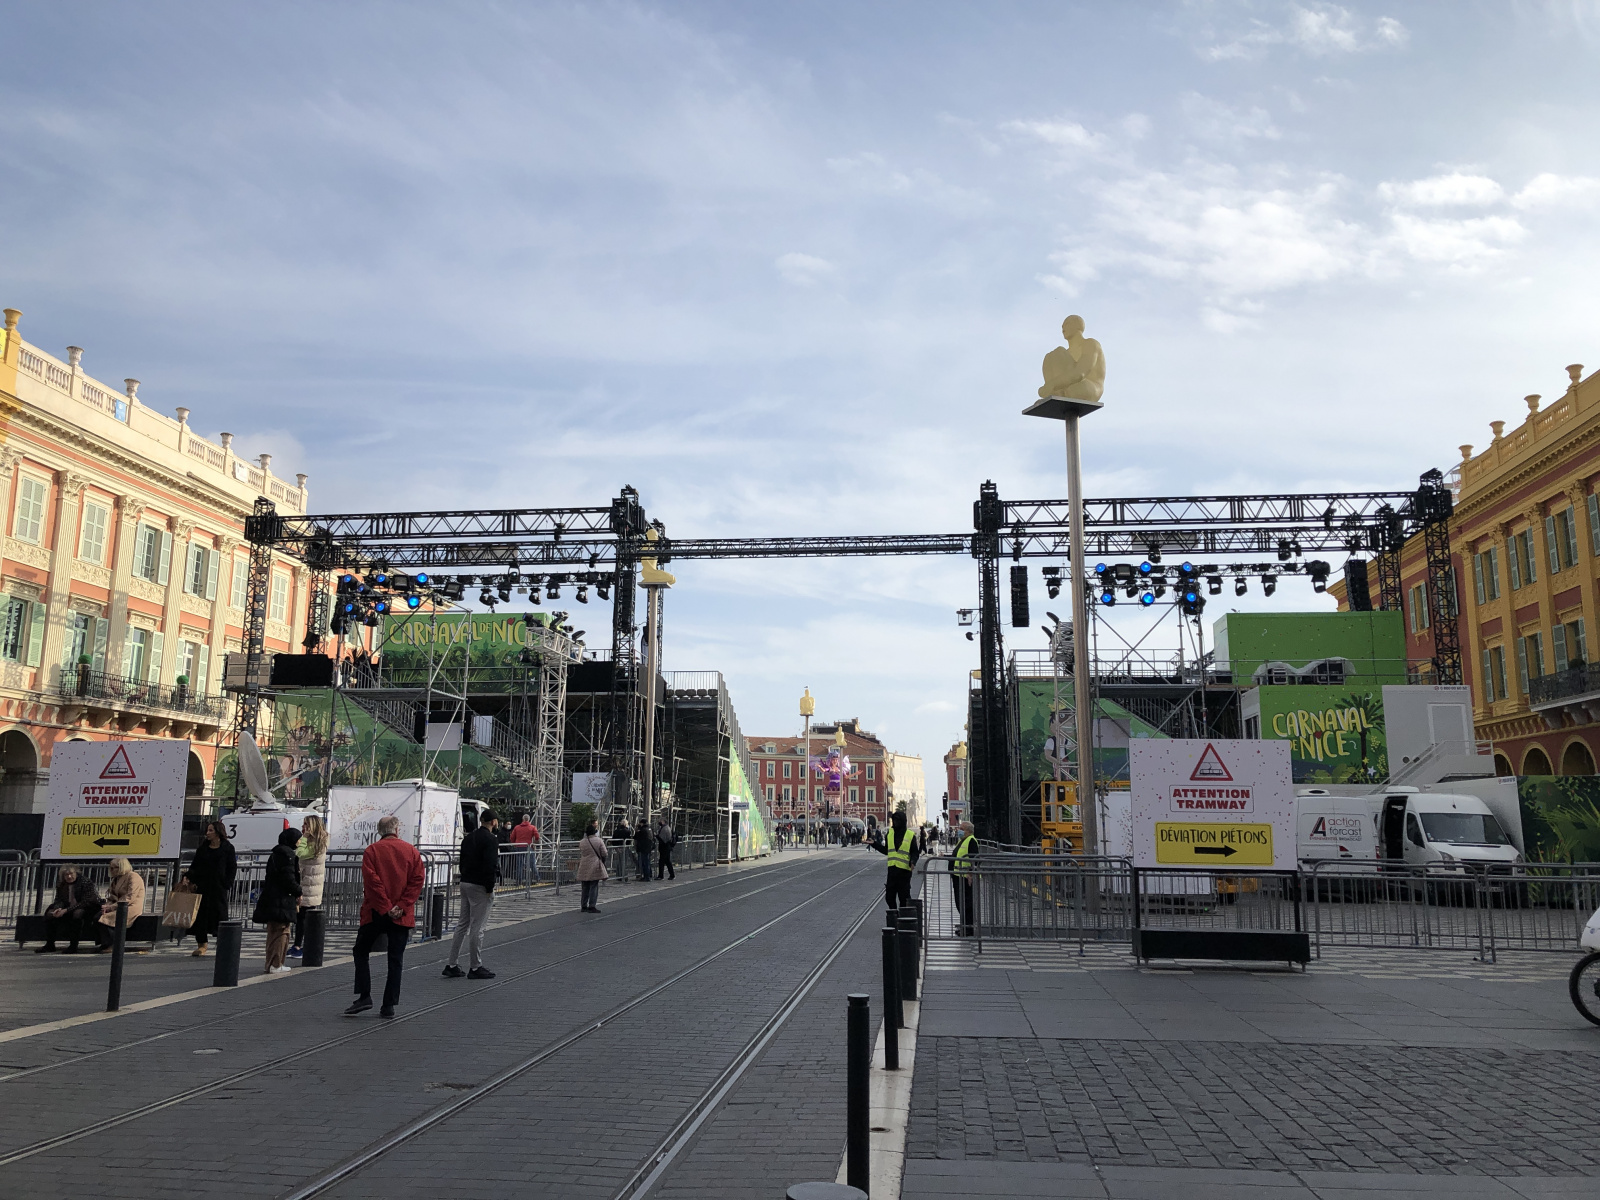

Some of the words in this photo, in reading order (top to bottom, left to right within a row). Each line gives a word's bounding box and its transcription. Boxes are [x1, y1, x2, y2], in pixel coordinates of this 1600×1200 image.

[389, 621, 482, 646] CARNAVAL
[480, 622, 490, 633] DE
[1272, 707, 1373, 738] CARNAVAL
[1300, 730, 1350, 762] NICE
[82, 786, 148, 795] ATTENTION
[1172, 788, 1250, 799] ATTENTION
[84, 796, 144, 805] TRAMWAY
[1176, 799, 1247, 810] TRAMWAY
[353, 821, 378, 831] CARNA
[1328, 818, 1360, 826] action
[66, 821, 115, 836] DÉVIATION
[117, 821, 157, 836] PIÉTONS
[1329, 827, 1362, 836] forcast
[362, 832, 379, 846] NIC
[1160, 827, 1217, 843] DÉVIATION
[1220, 828, 1268, 844] PIÉTONS
